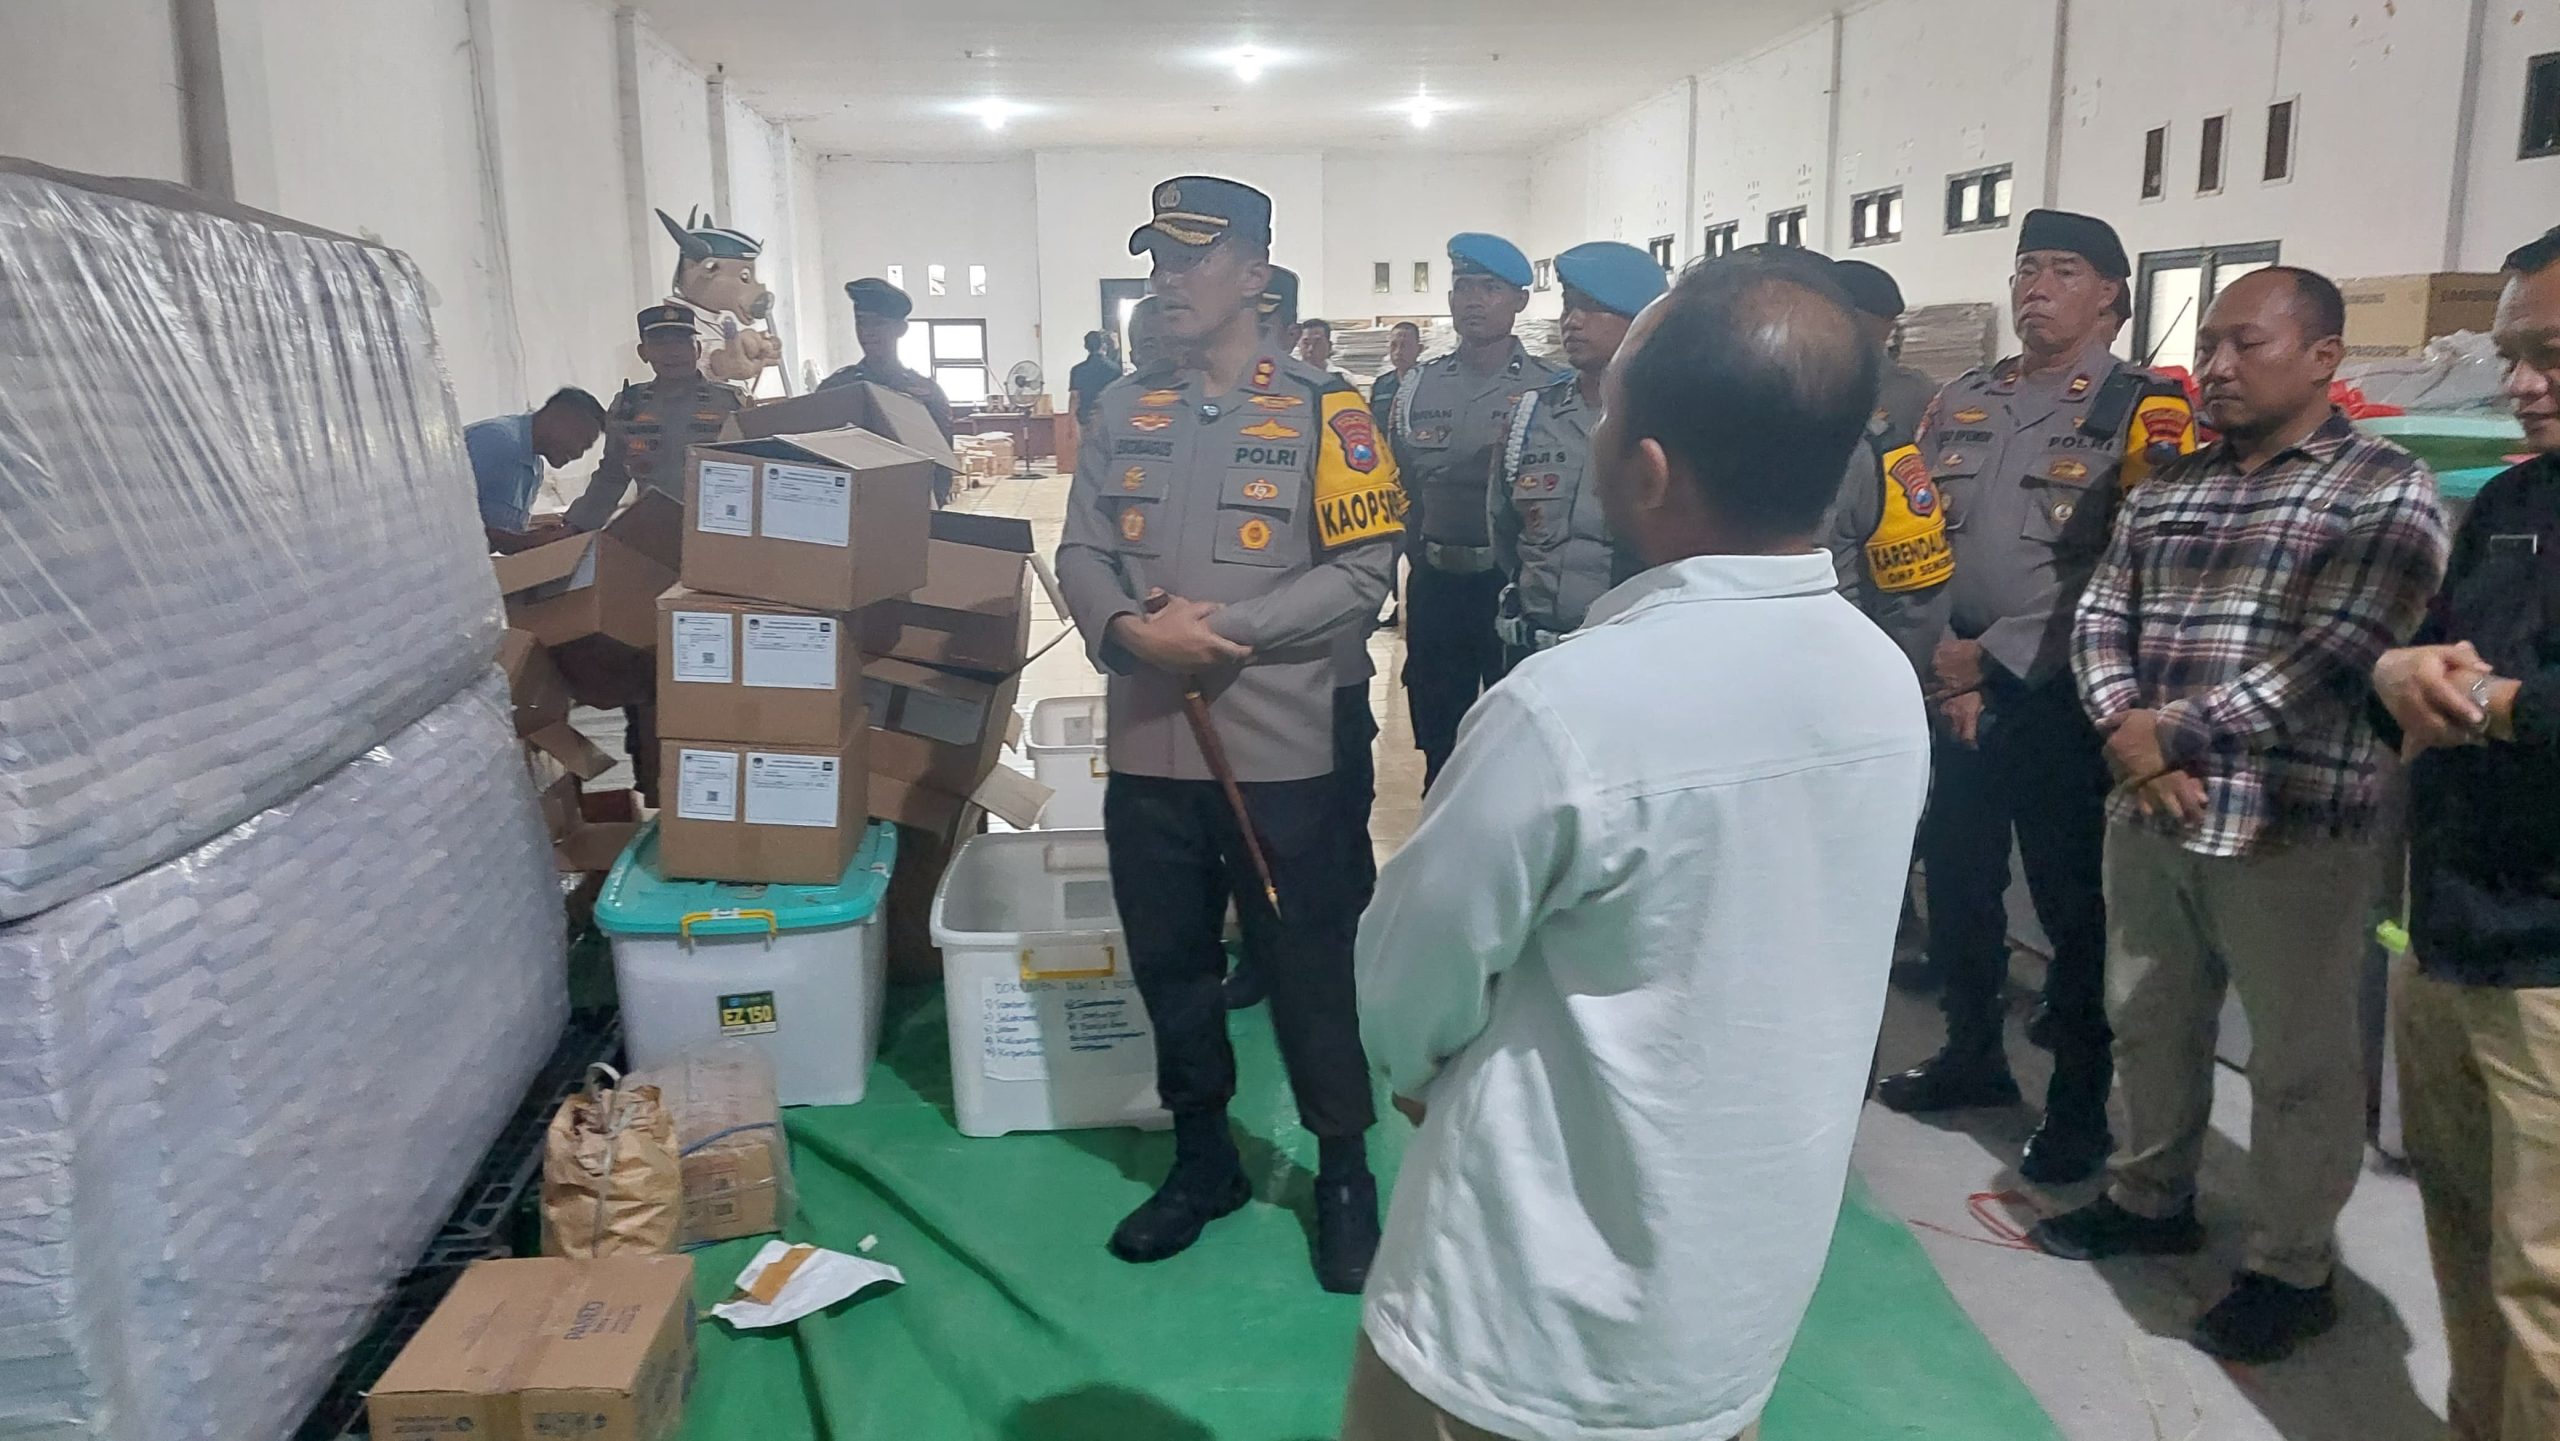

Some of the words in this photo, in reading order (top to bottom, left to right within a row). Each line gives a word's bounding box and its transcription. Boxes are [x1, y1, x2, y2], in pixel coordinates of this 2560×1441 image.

[1235, 447, 1297, 466] POLRI
[722, 1008, 747, 1026] EZ
[746, 1005, 773, 1023] 150
